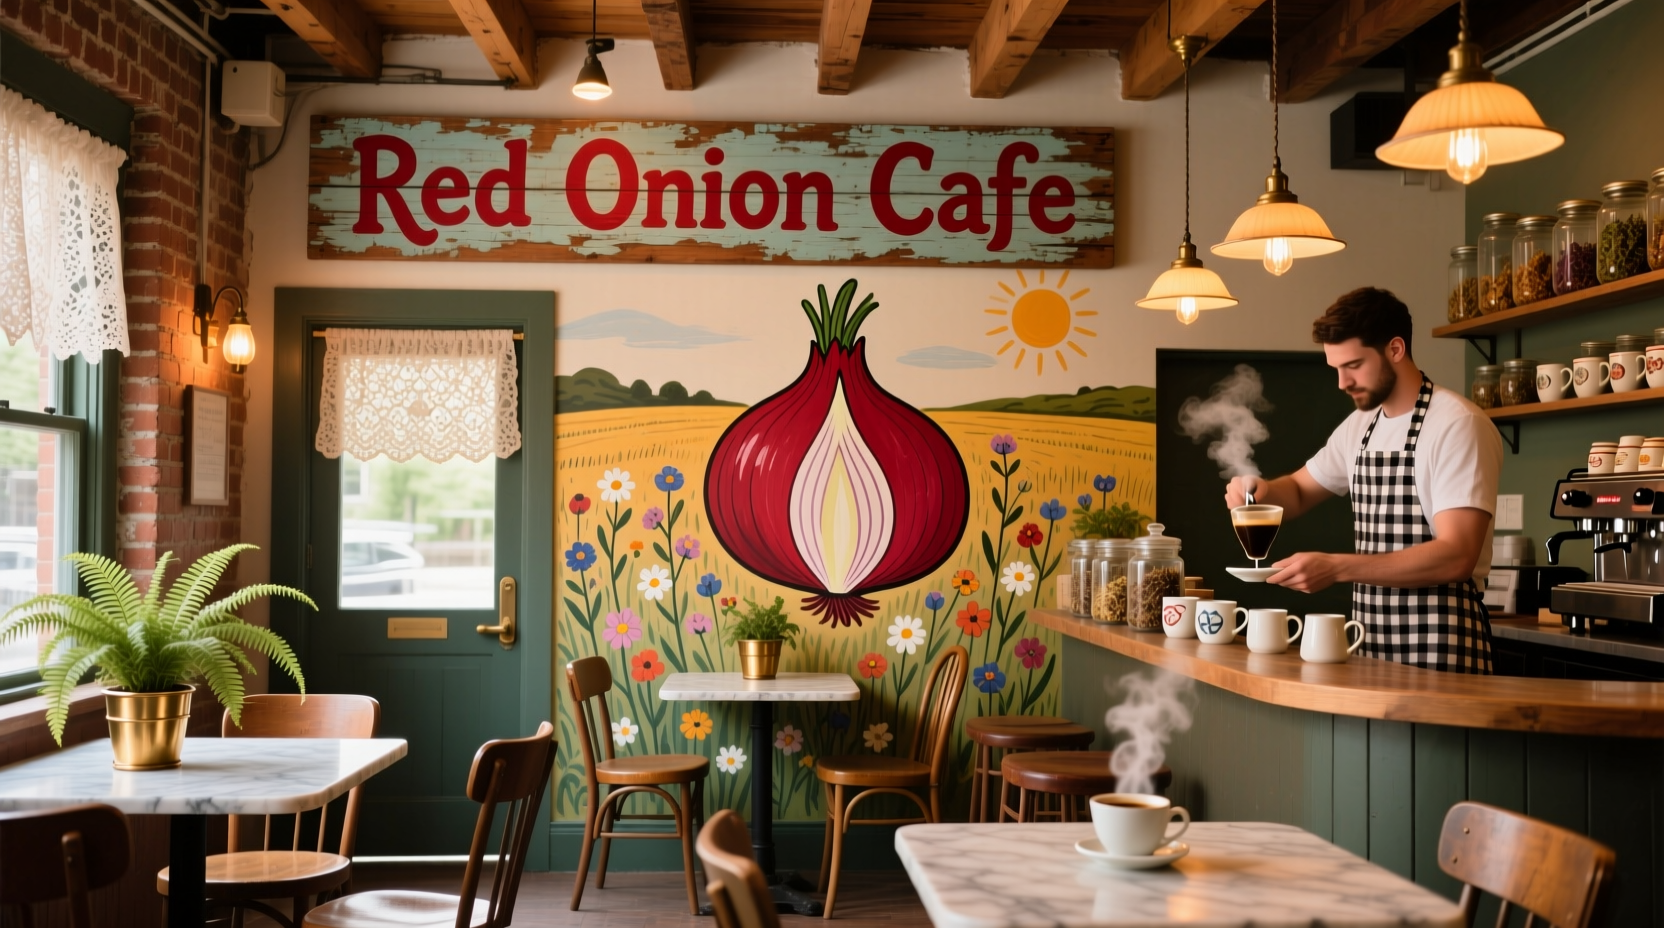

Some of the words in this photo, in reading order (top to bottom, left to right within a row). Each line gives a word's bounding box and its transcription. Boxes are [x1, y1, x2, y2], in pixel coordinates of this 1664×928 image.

[353, 135, 530, 246] Red
[565, 138, 838, 231] Onion
[870, 141, 1076, 251] Cafe
